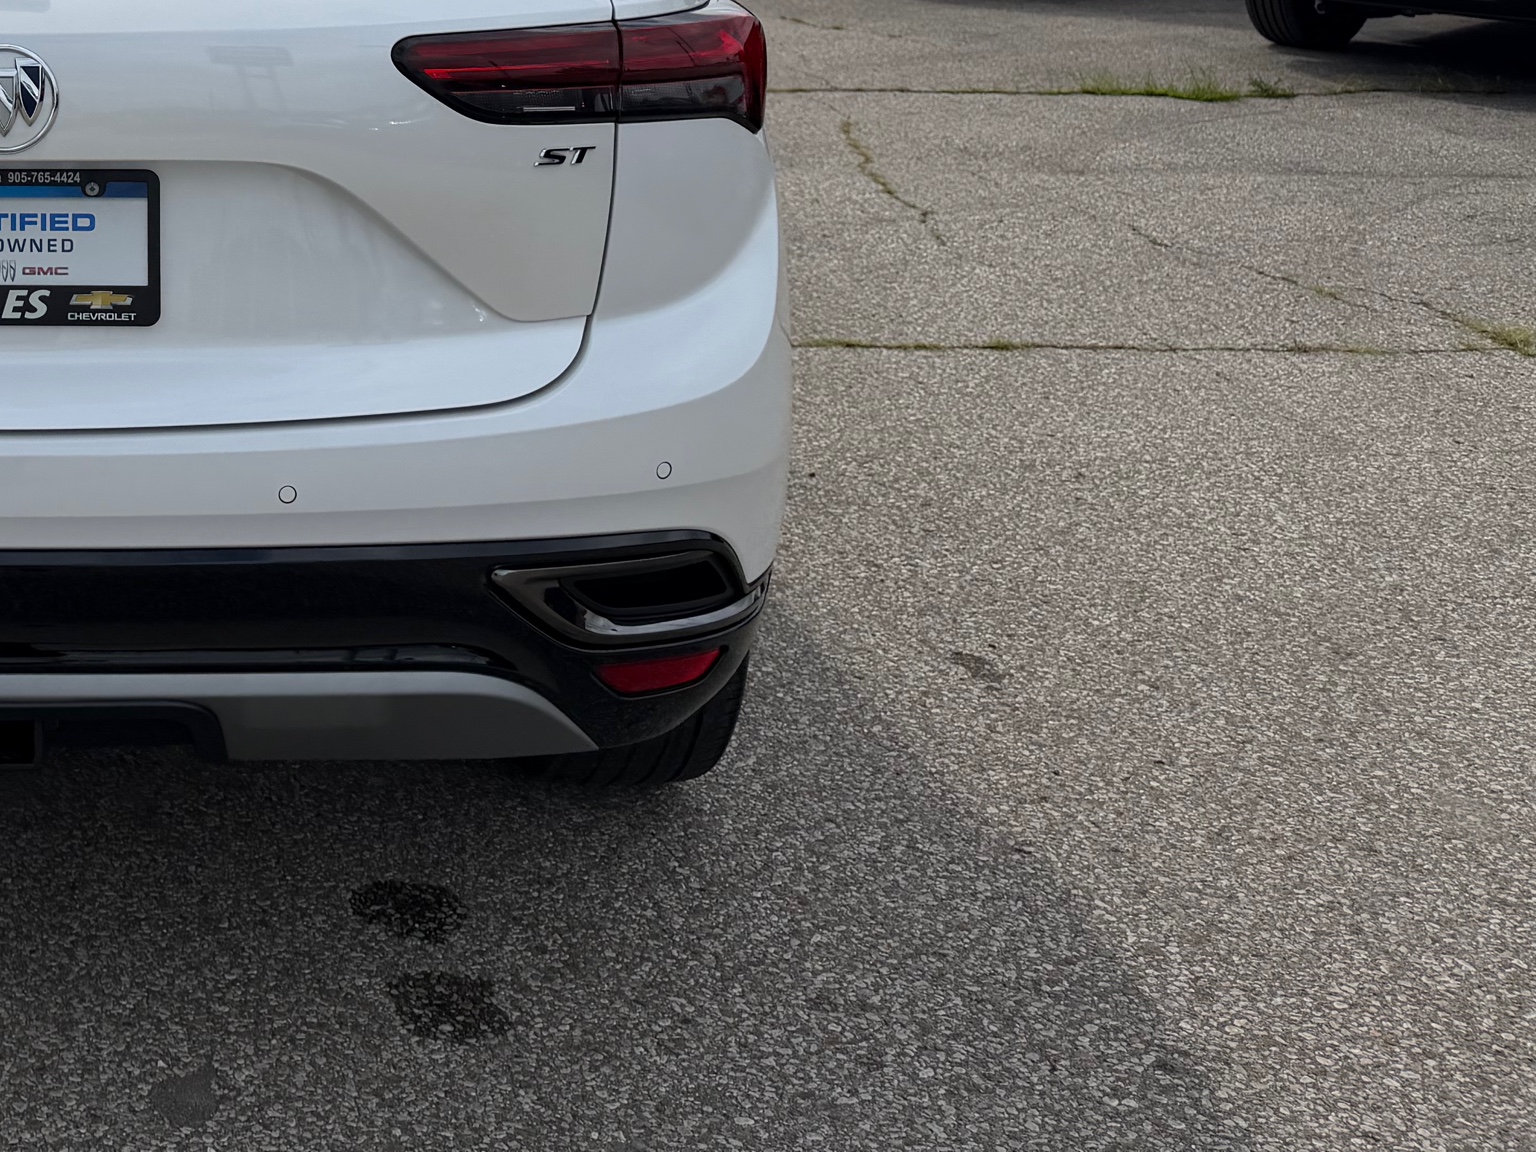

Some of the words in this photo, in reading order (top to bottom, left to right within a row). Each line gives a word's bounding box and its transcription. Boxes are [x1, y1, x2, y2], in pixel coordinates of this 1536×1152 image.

[533, 145, 596, 167] ST
[7, 171, 81, 183] 905-765-4424
[21, 266, 69, 276] GMC
[67, 312, 137, 321] CHEVROLET
